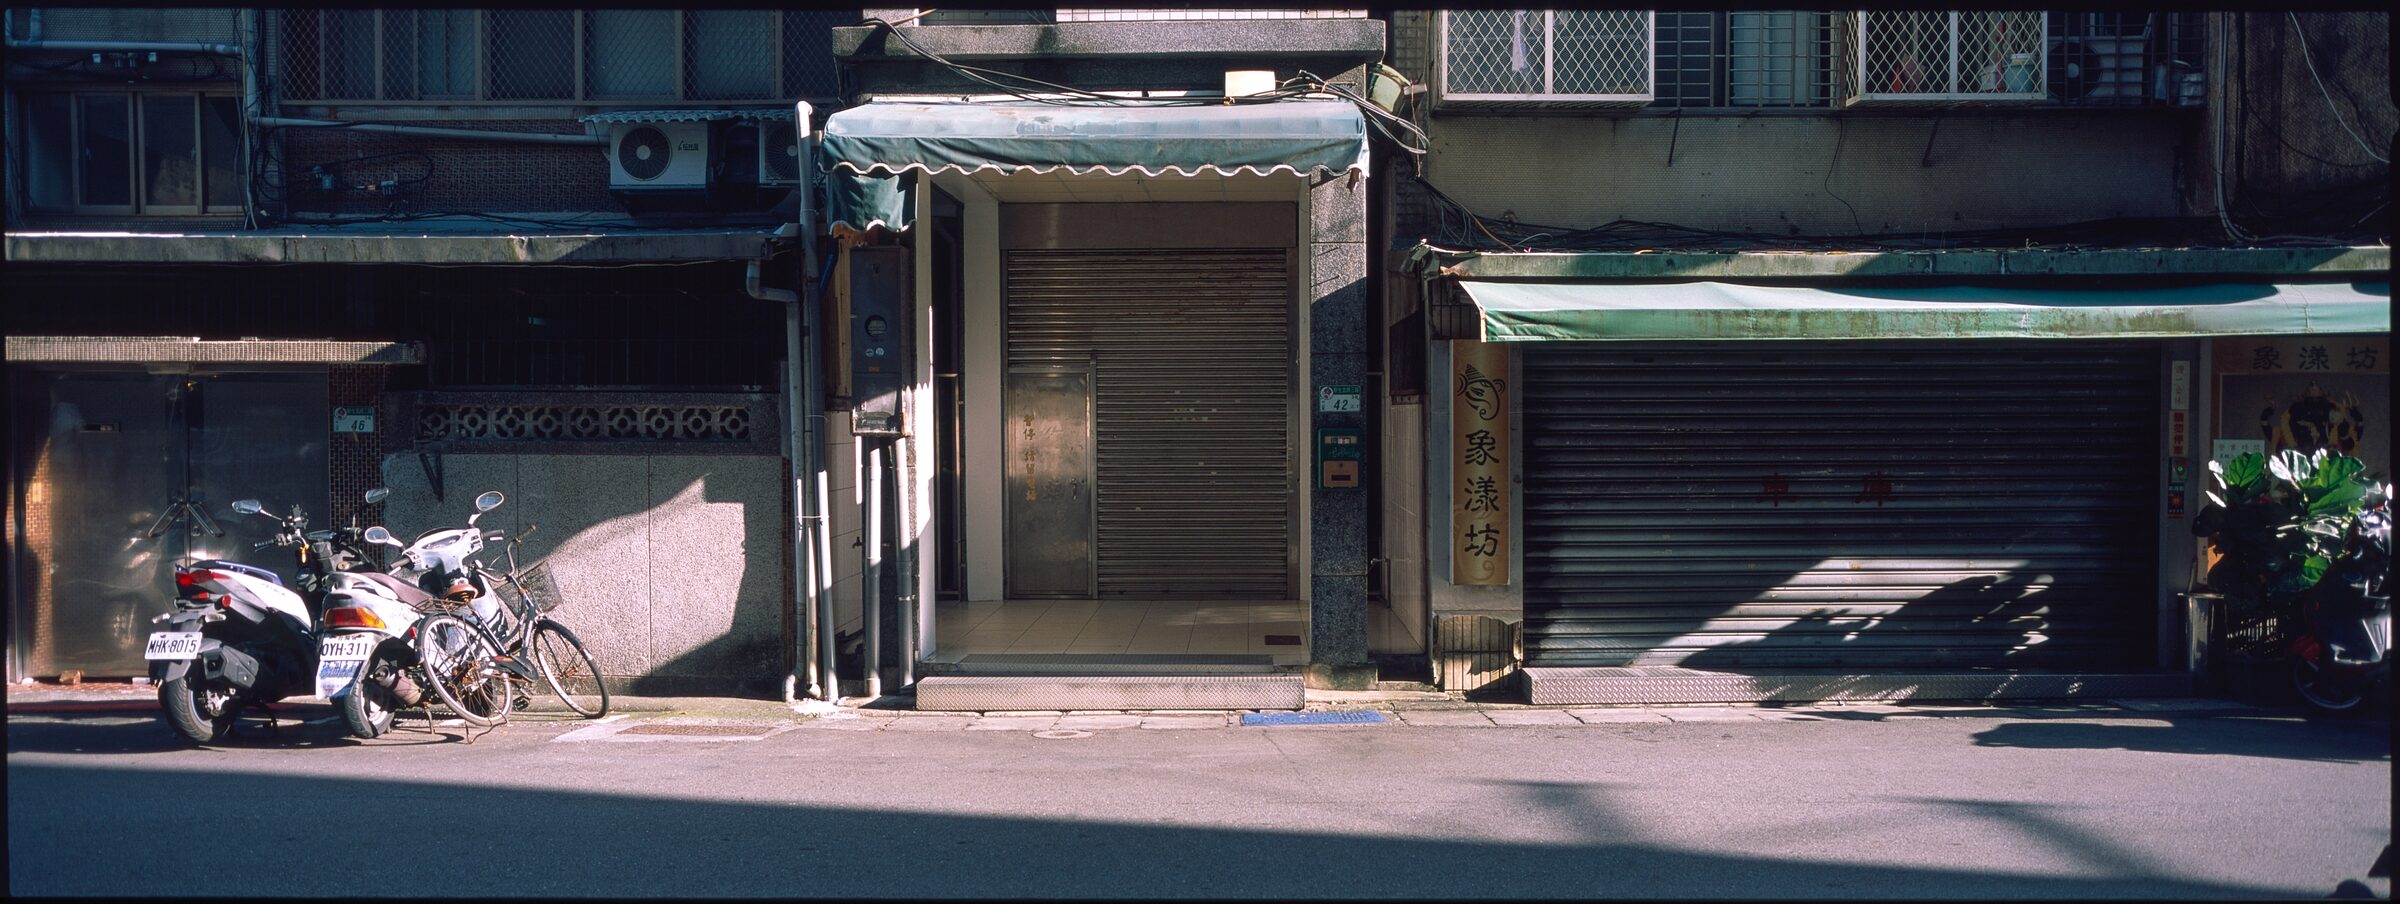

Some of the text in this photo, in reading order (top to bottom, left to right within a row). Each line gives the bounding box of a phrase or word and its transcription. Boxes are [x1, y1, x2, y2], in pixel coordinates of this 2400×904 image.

[2253, 346, 2378, 369] 象漾坊
[1334, 400, 1348, 410] 42
[352, 420, 365, 430] 46
[1464, 429, 1500, 557] 象漾坊
